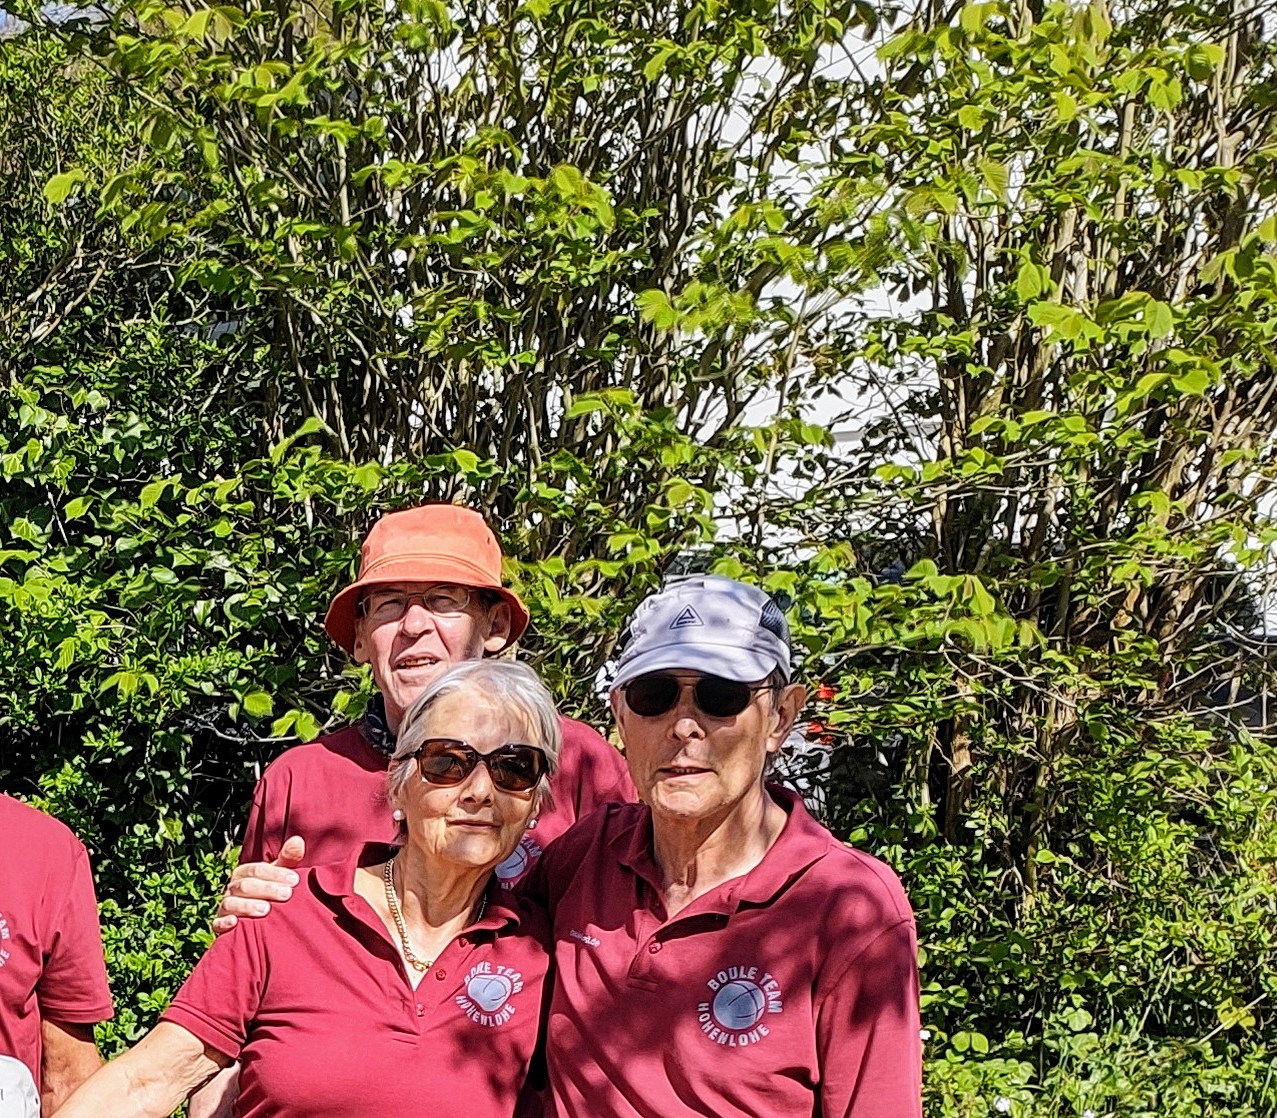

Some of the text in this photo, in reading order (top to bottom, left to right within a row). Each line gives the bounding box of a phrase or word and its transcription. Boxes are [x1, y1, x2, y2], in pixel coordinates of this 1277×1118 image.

[496, 965, 524, 995] TEAM
[707, 965, 784, 1014] BOULE TEAM
[455, 995, 516, 1027] HOHENLOHE
[697, 1002, 771, 1047] HOHENLOHE
